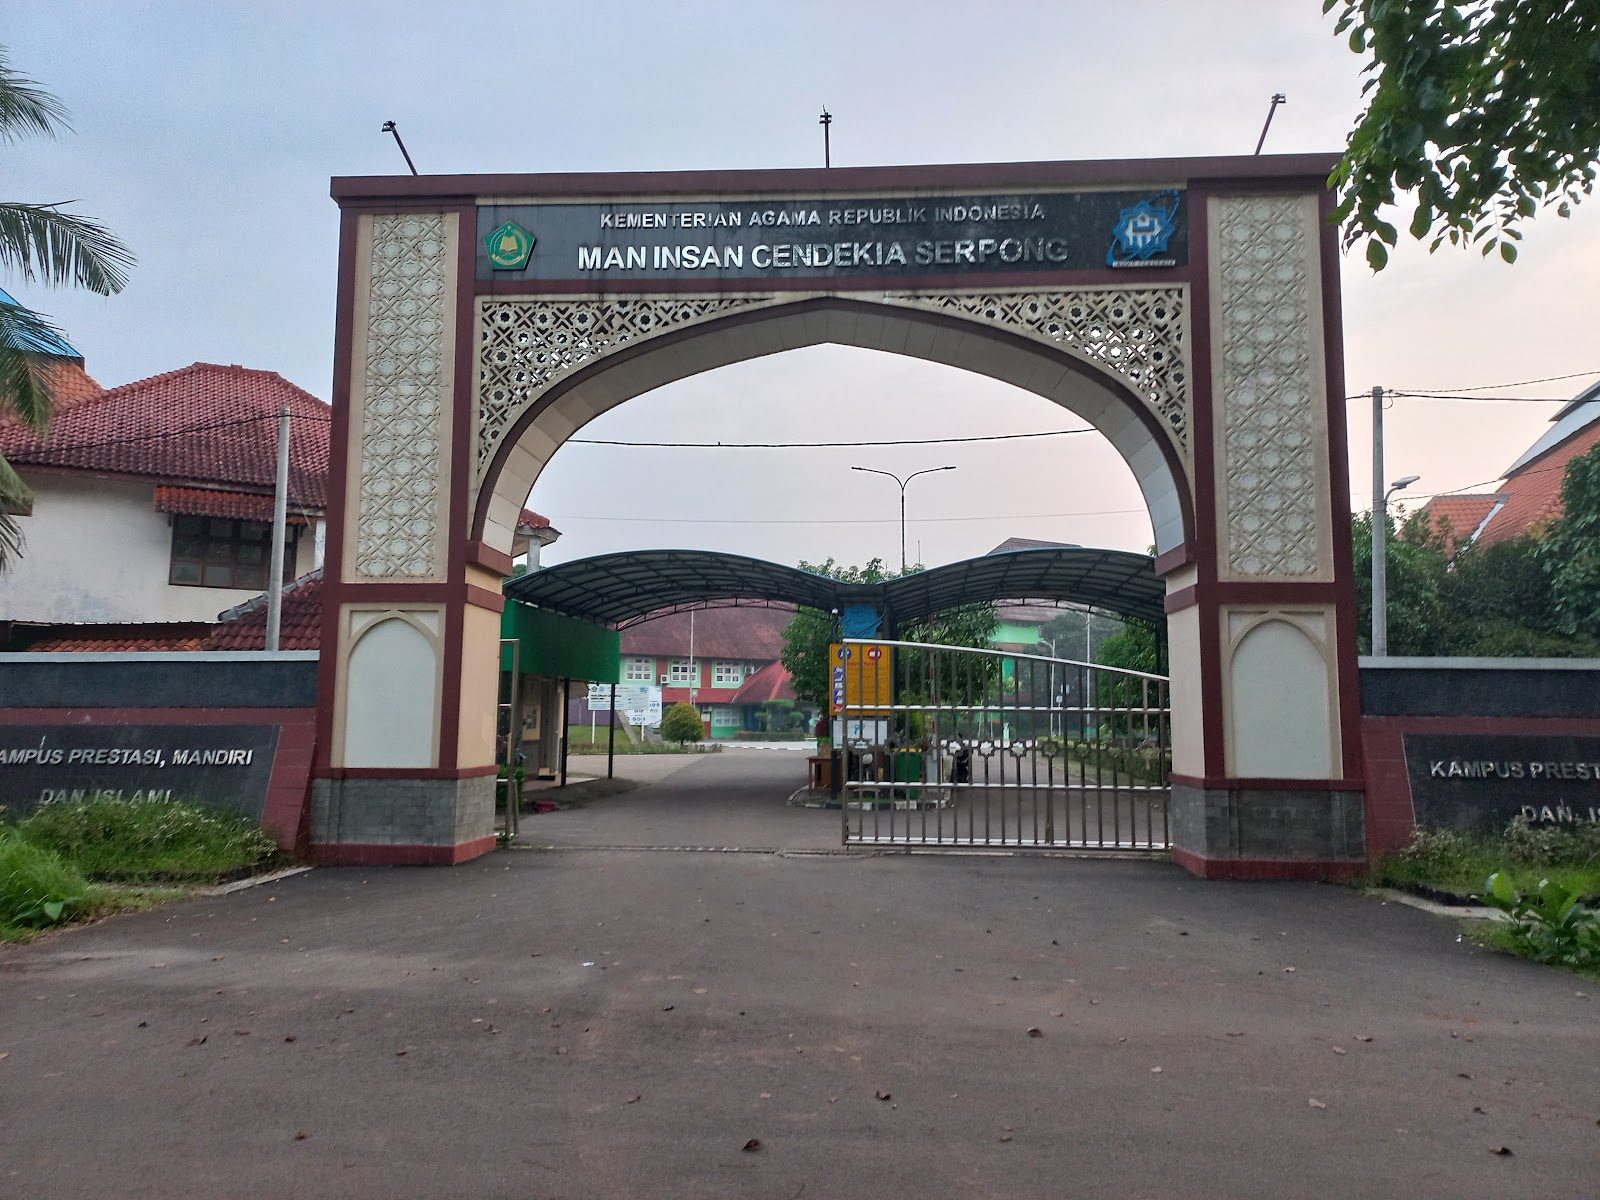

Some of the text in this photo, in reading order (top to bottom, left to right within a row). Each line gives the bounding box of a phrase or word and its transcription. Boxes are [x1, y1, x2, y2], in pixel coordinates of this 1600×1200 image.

[600, 204, 1046, 229] KEMENTERIAN AGAMA REPUBLIK INDONESIA
[578, 238, 1068, 270] MAN INSAN CENDEKIA SERPONG
[67, 749, 167, 768] PRESTASI,
[172, 749, 254, 766] MANDIRI
[1429, 760, 1526, 779] KAMPUS
[38, 788, 85, 805] DAN
[1520, 804, 1574, 823] DAN
